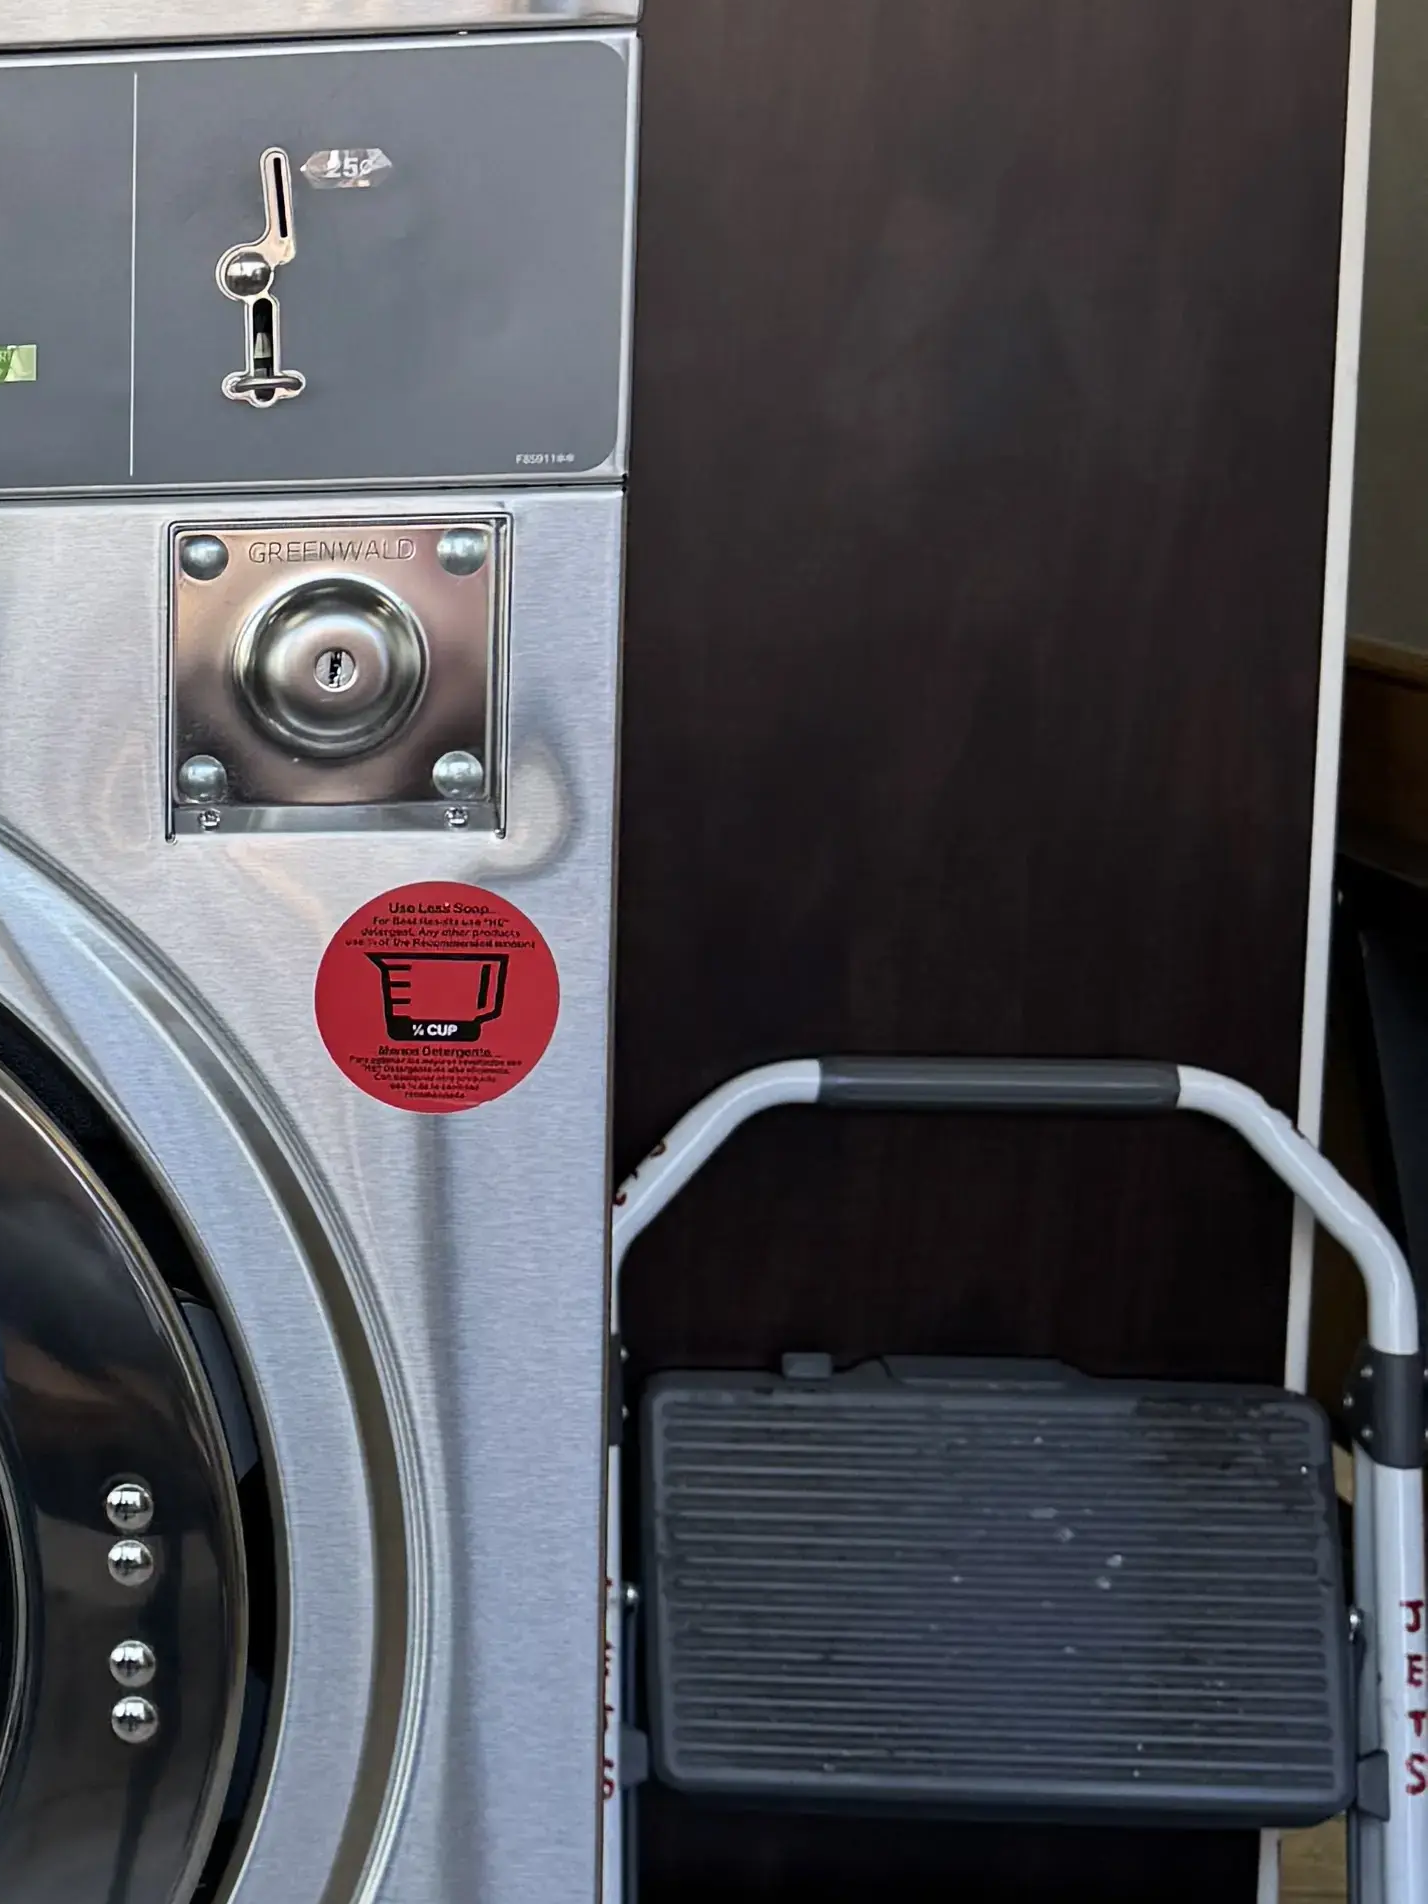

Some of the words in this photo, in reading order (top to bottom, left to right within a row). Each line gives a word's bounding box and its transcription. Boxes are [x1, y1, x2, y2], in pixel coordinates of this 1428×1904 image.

[248, 537, 417, 565] GREENWALD
[388, 902, 416, 915] Use
[372, 916, 390, 926] For
[418, 928, 439, 938] Any
[442, 928, 470, 938] other
[472, 929, 521, 939] products
[426, 1023, 458, 1037] CUP
[1400, 1599, 1428, 1796] JETS
